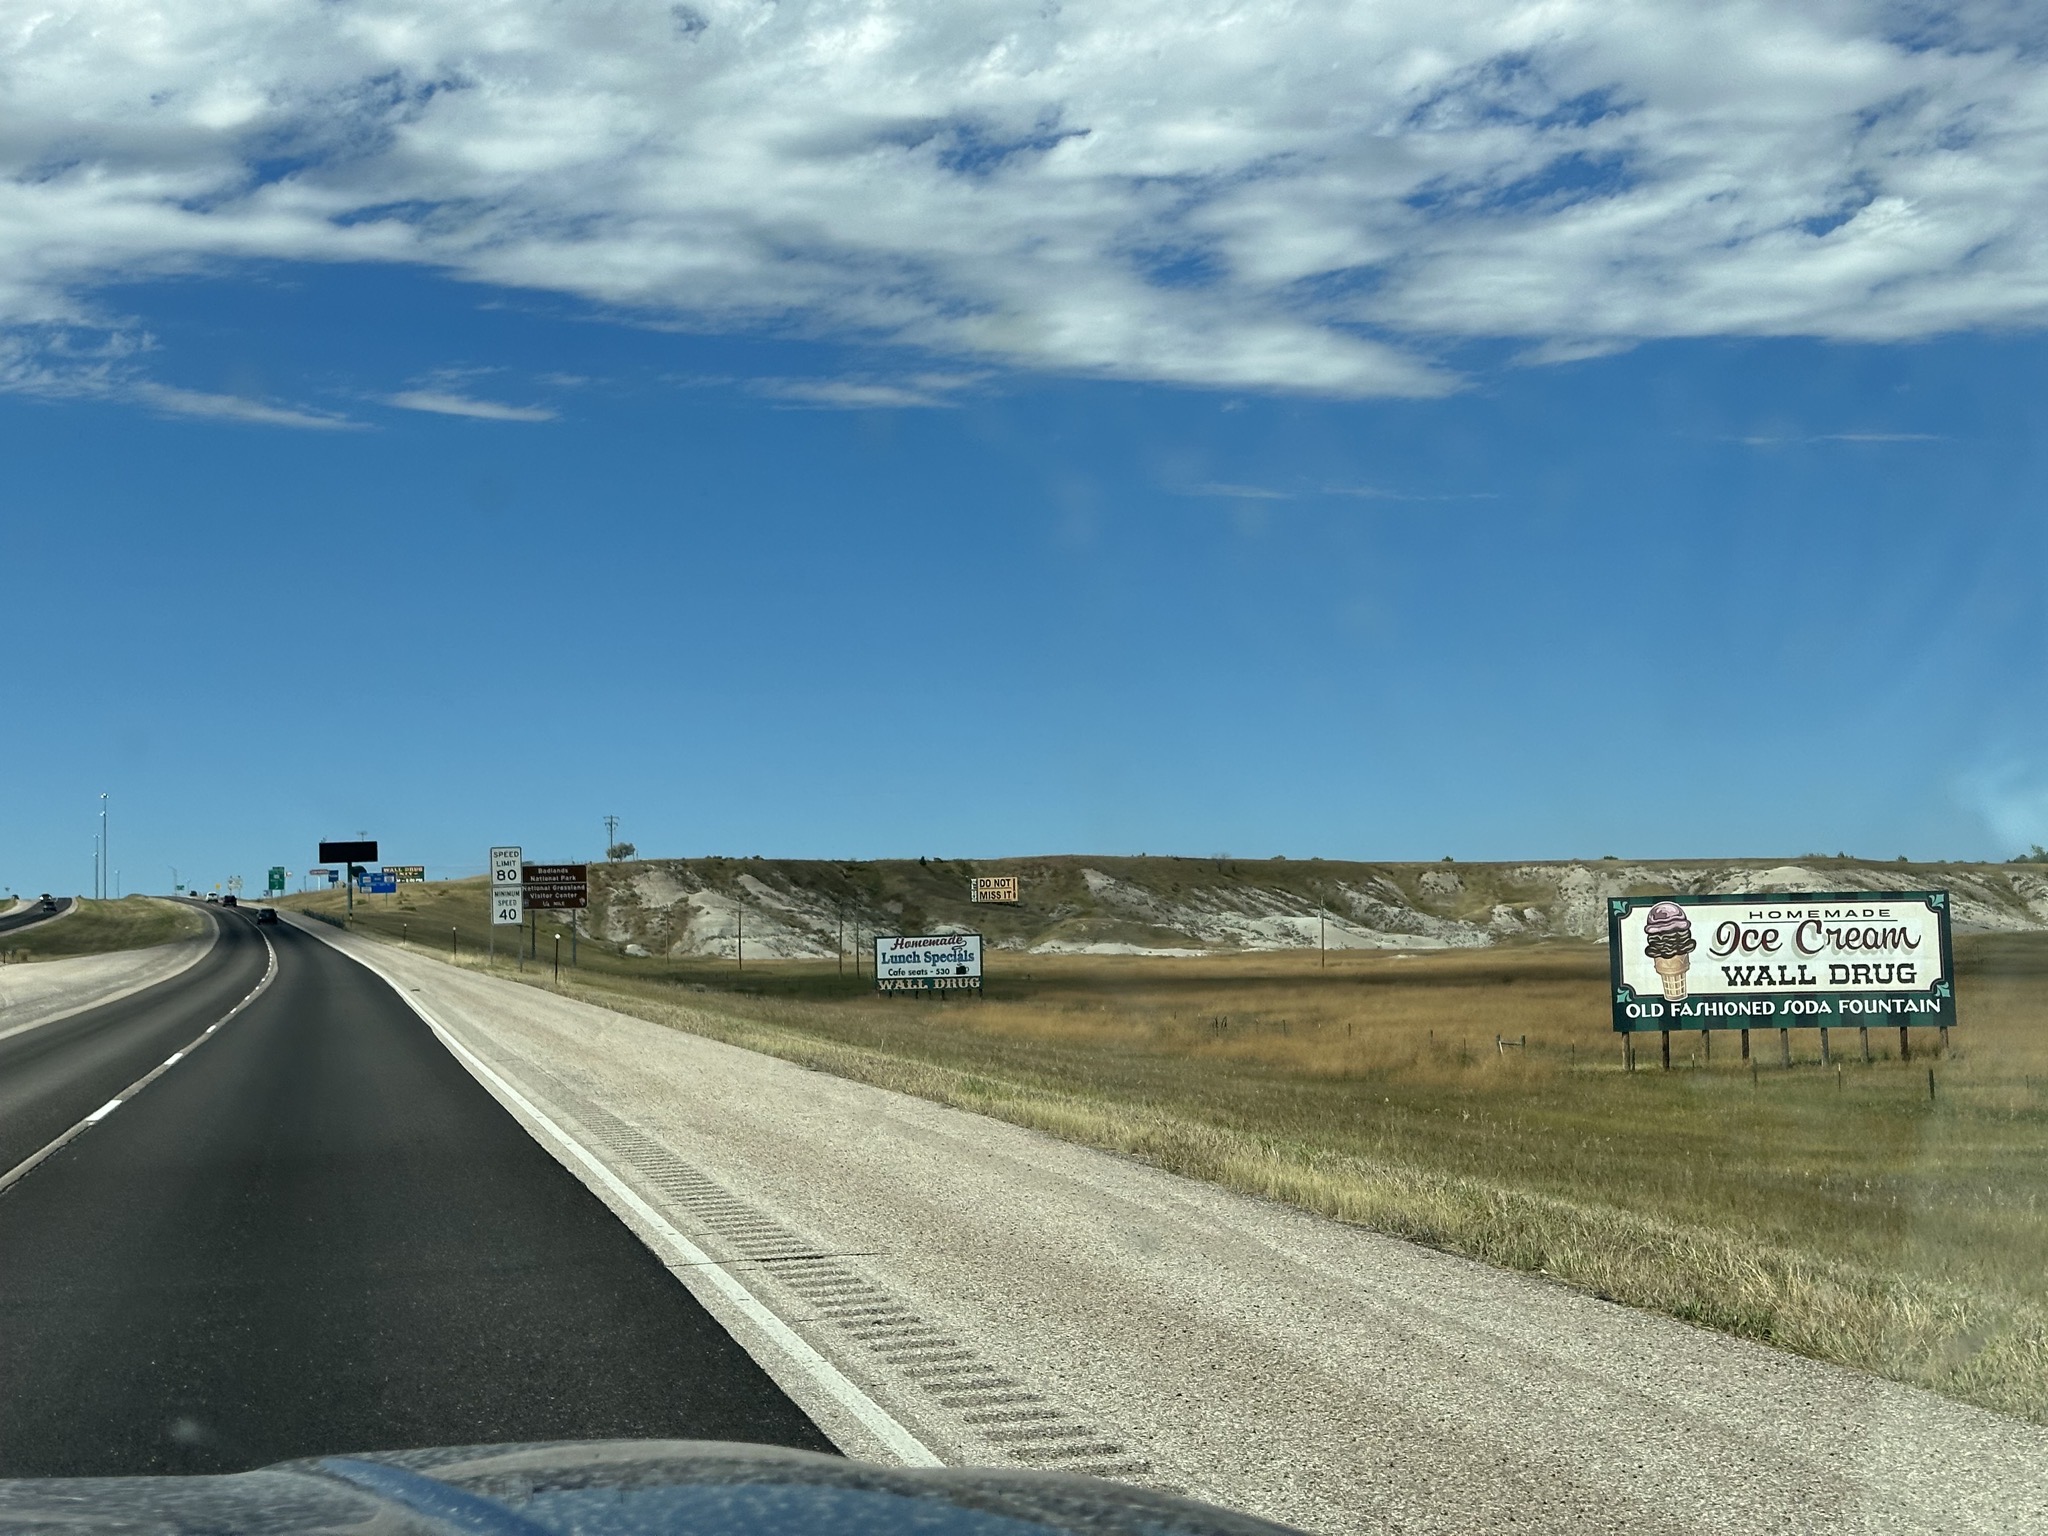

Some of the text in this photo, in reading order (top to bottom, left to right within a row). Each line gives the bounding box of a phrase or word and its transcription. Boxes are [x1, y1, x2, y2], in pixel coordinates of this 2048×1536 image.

[493, 850, 520, 858] SPEED
[496, 869, 517, 881] 80
[980, 879, 991, 887] DO
[994, 878, 1011, 887] NOT
[980, 890, 1002, 900] MISS
[499, 908, 517, 920] 40
[1749, 909, 1891, 919] HOMEMADE
[890, 935, 964, 951] Homemade
[1709, 919, 1922, 957] Ice Cream
[881, 950, 975, 967] Lunch Specials
[888, 968, 906, 976] Cafe
[908, 968, 928, 976] seats
[1721, 963, 1918, 987] WALL DRUG
[878, 977, 980, 991] WALL DRUG
[1625, 997, 1941, 1018] OLD FASHIONED SODA FOUNTAIN
